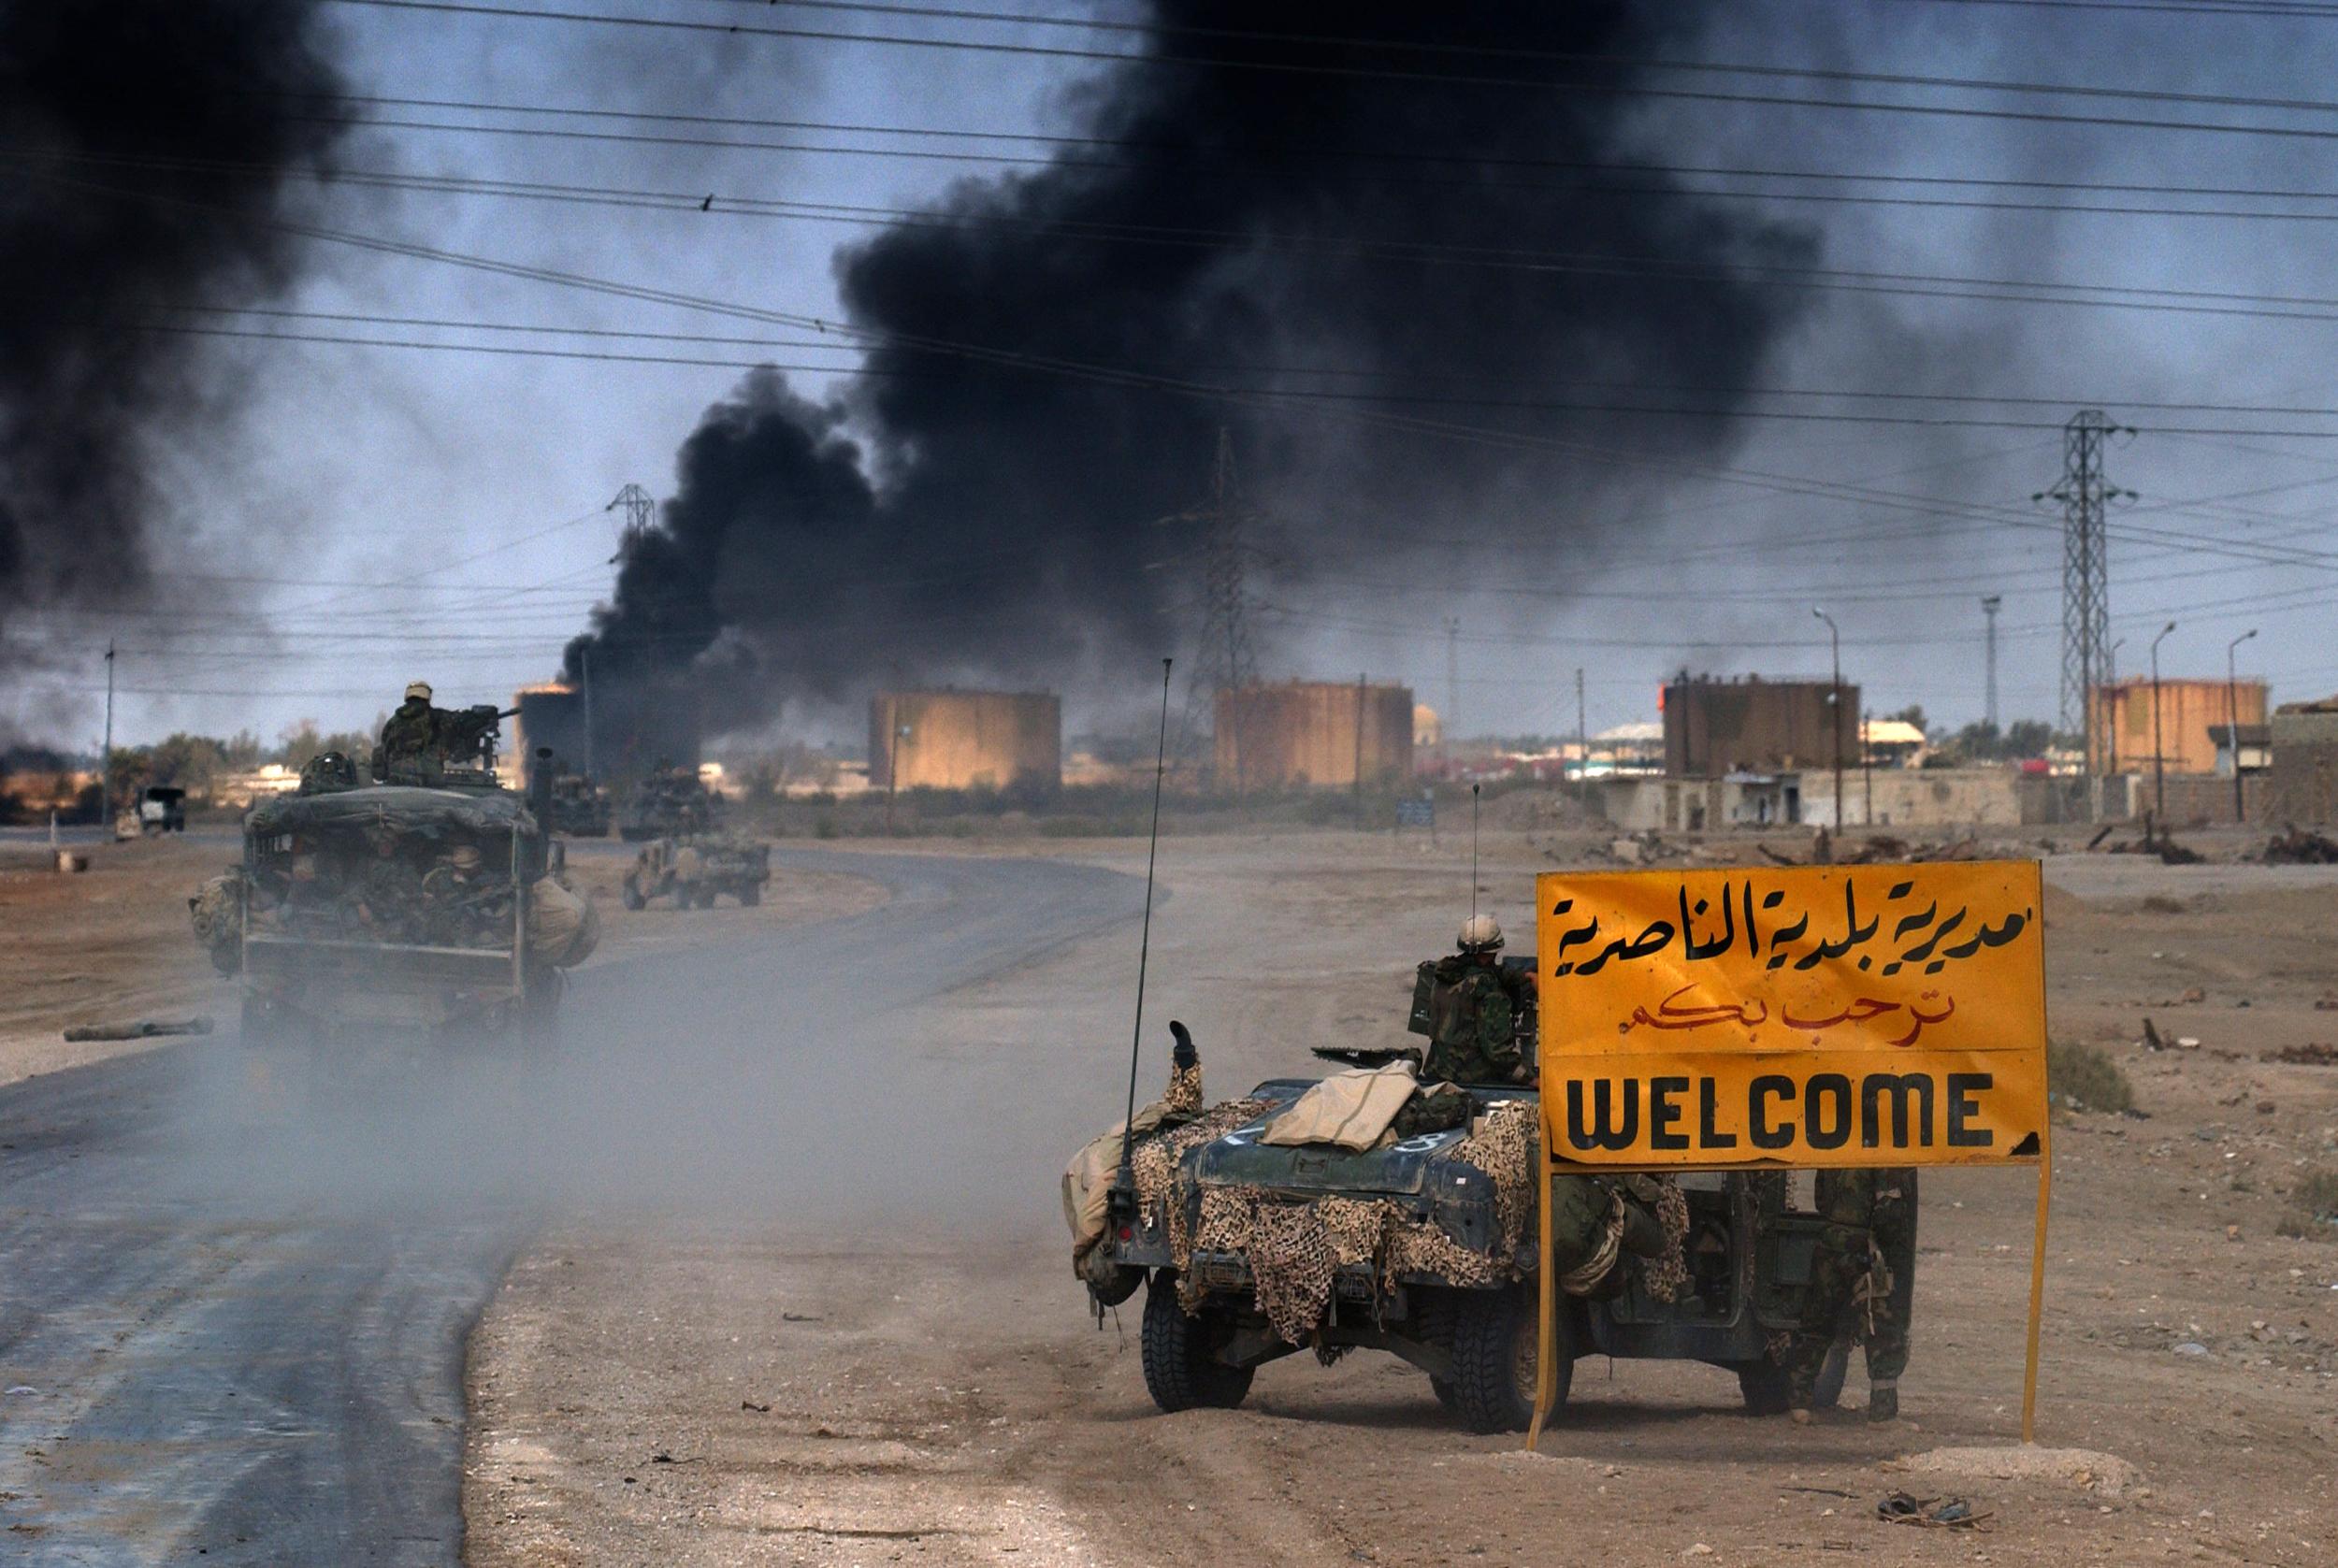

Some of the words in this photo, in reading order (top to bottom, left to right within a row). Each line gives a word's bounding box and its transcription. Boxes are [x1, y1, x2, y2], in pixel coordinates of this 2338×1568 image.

[1552, 879, 1759, 977] الناصرية
[1763, 878, 1880, 971] بلدية
[1882, 881, 2027, 976] مديرية
[1619, 982, 1768, 1044] بكم
[1781, 988, 1956, 1048] ترحب
[1566, 1072, 1994, 1151] WELCOME
